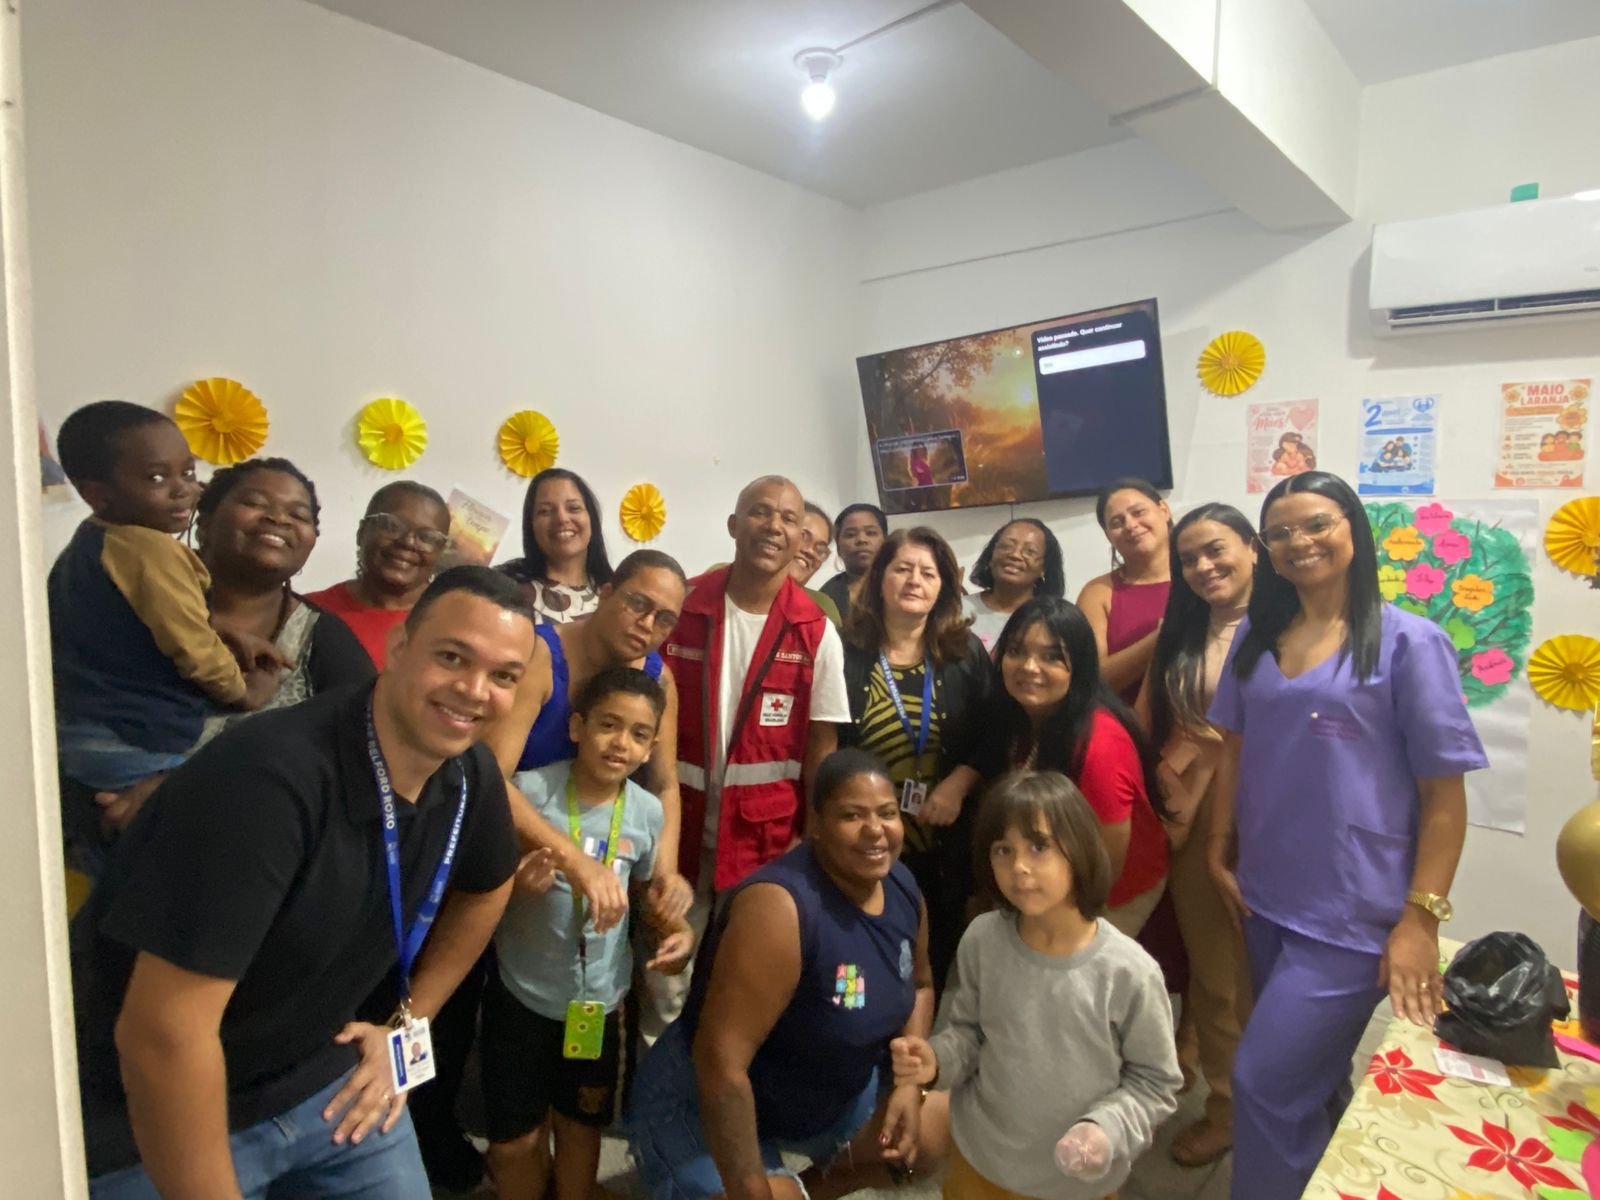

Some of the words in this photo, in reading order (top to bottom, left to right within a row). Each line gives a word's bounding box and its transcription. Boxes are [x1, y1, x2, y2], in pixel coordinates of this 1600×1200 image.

[1520, 395, 1569, 406] LARANJA
[1527, 383, 1565, 396] MAIO
[1364, 404, 1382, 428] 2
[367, 741, 391, 794] BELFORD
[383, 794, 396, 830] ROXO
[443, 794, 467, 865] PREFEITURA
